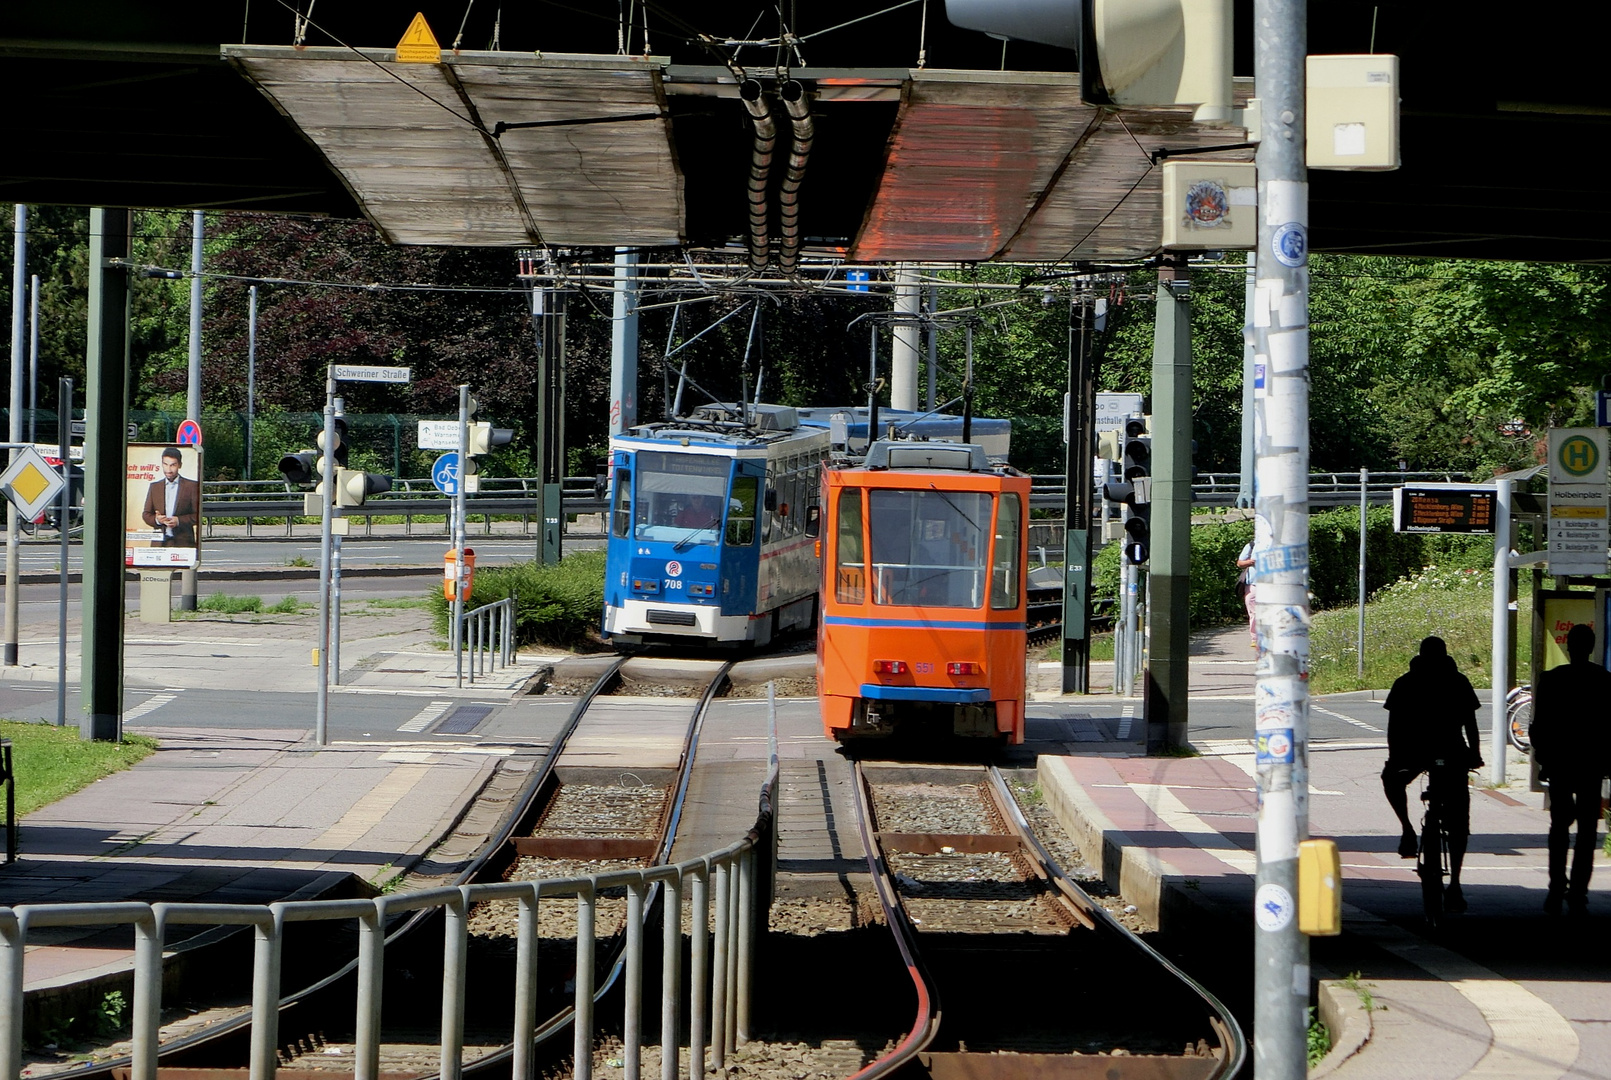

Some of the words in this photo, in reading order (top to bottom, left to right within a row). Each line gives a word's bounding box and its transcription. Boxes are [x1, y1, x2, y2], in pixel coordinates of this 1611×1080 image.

[337, 367, 379, 379] Schweriner
[382, 369, 407, 379] Straße
[1097, 416, 1122, 425] nsthalle
[1554, 491, 1603, 500] Holbeinplatz
[664, 579, 683, 589] 708
[915, 662, 934, 674] 551
